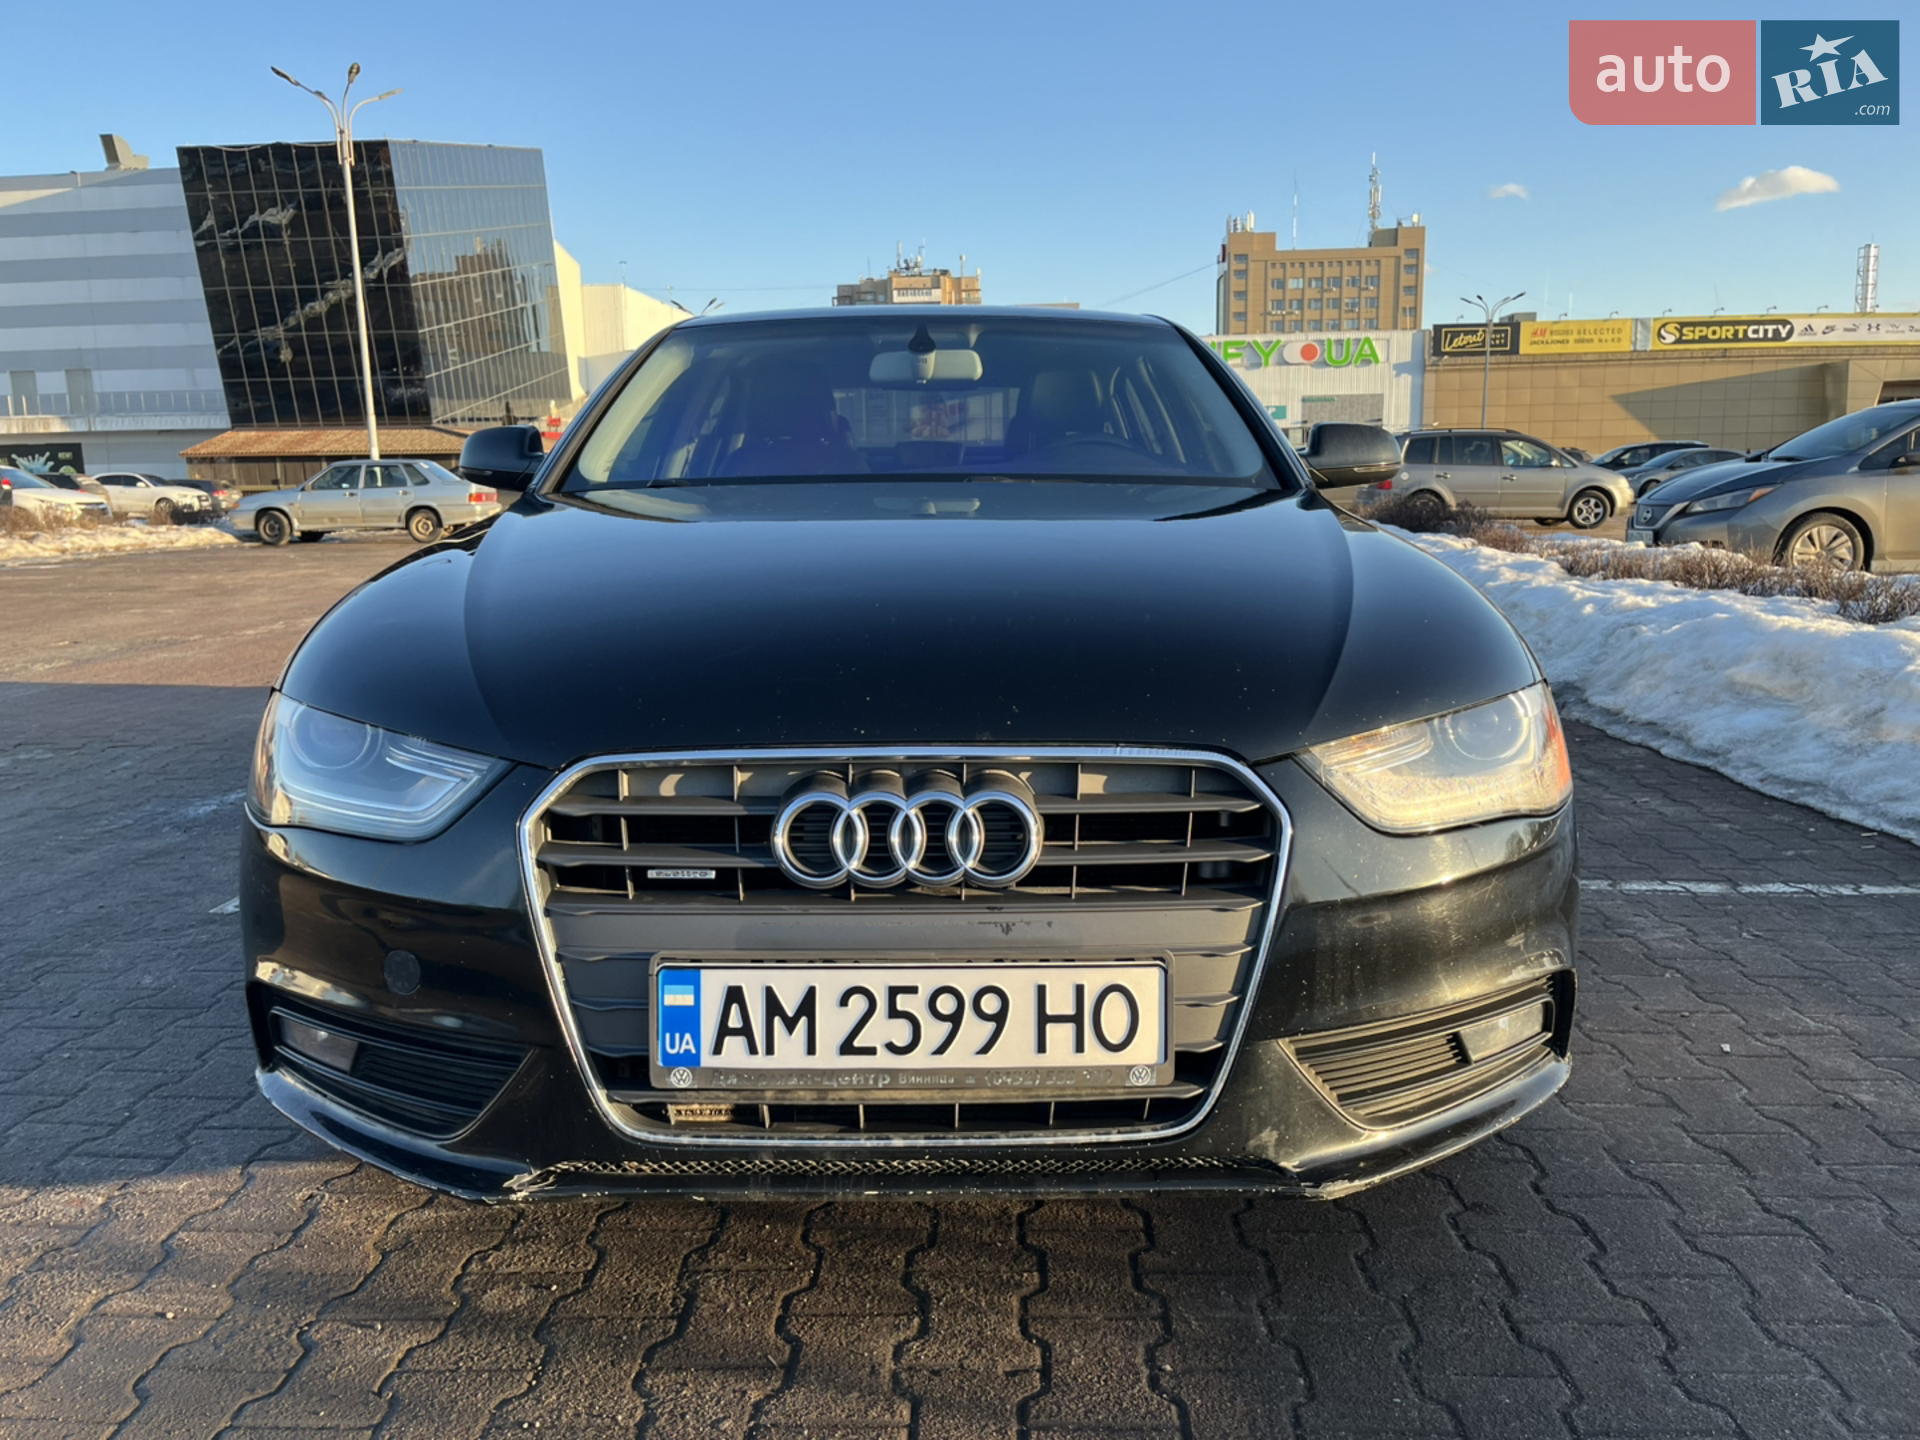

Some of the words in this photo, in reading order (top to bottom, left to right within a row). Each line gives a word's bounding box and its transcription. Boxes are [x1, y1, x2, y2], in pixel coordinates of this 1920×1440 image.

[1681, 323, 1792, 341] SPORTCITY
[709, 984, 818, 1057] AM
[838, 984, 1011, 1057] 2599
[1034, 982, 1141, 1056] HO
[665, 1033, 697, 1055] UA
